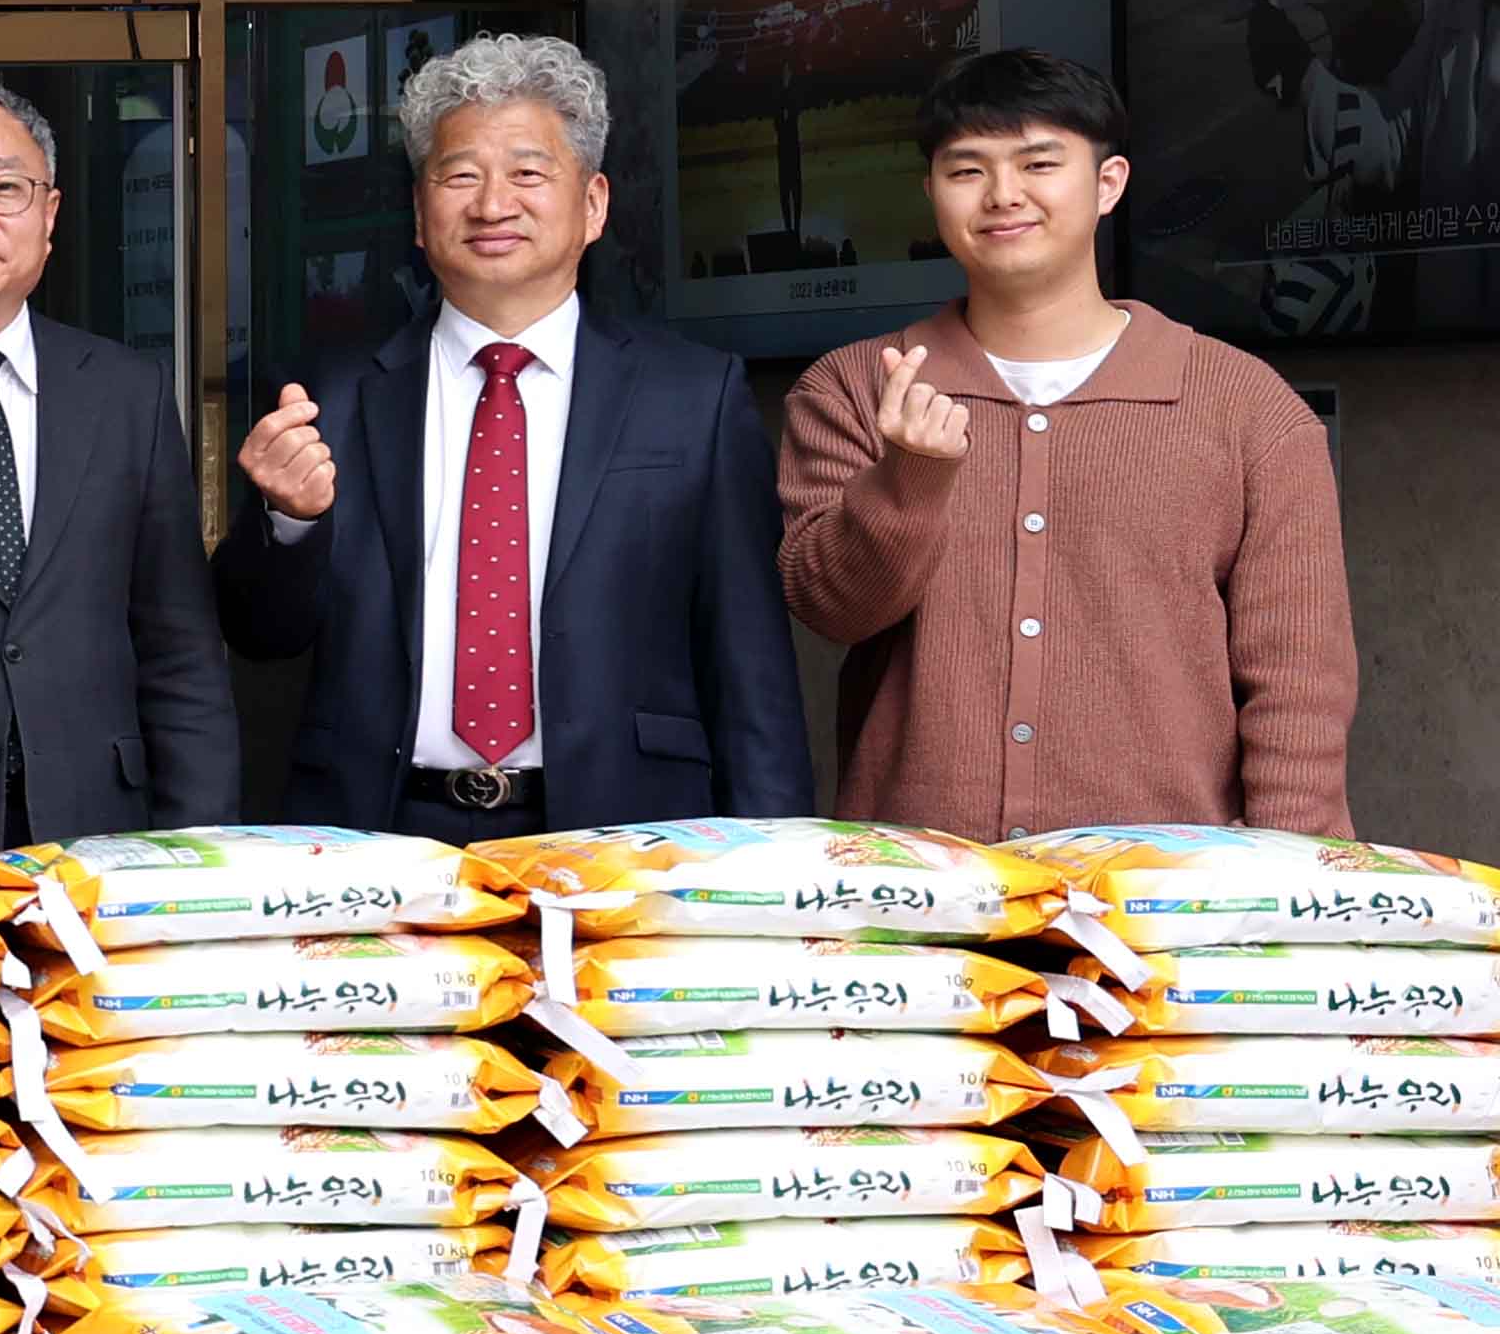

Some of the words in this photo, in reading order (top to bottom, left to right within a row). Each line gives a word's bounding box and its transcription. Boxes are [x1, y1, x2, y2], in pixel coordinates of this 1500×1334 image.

[1332, 210, 1403, 246] 행복하게
[1406, 205, 1460, 242] 살아갈
[1465, 204, 1484, 235] 수
